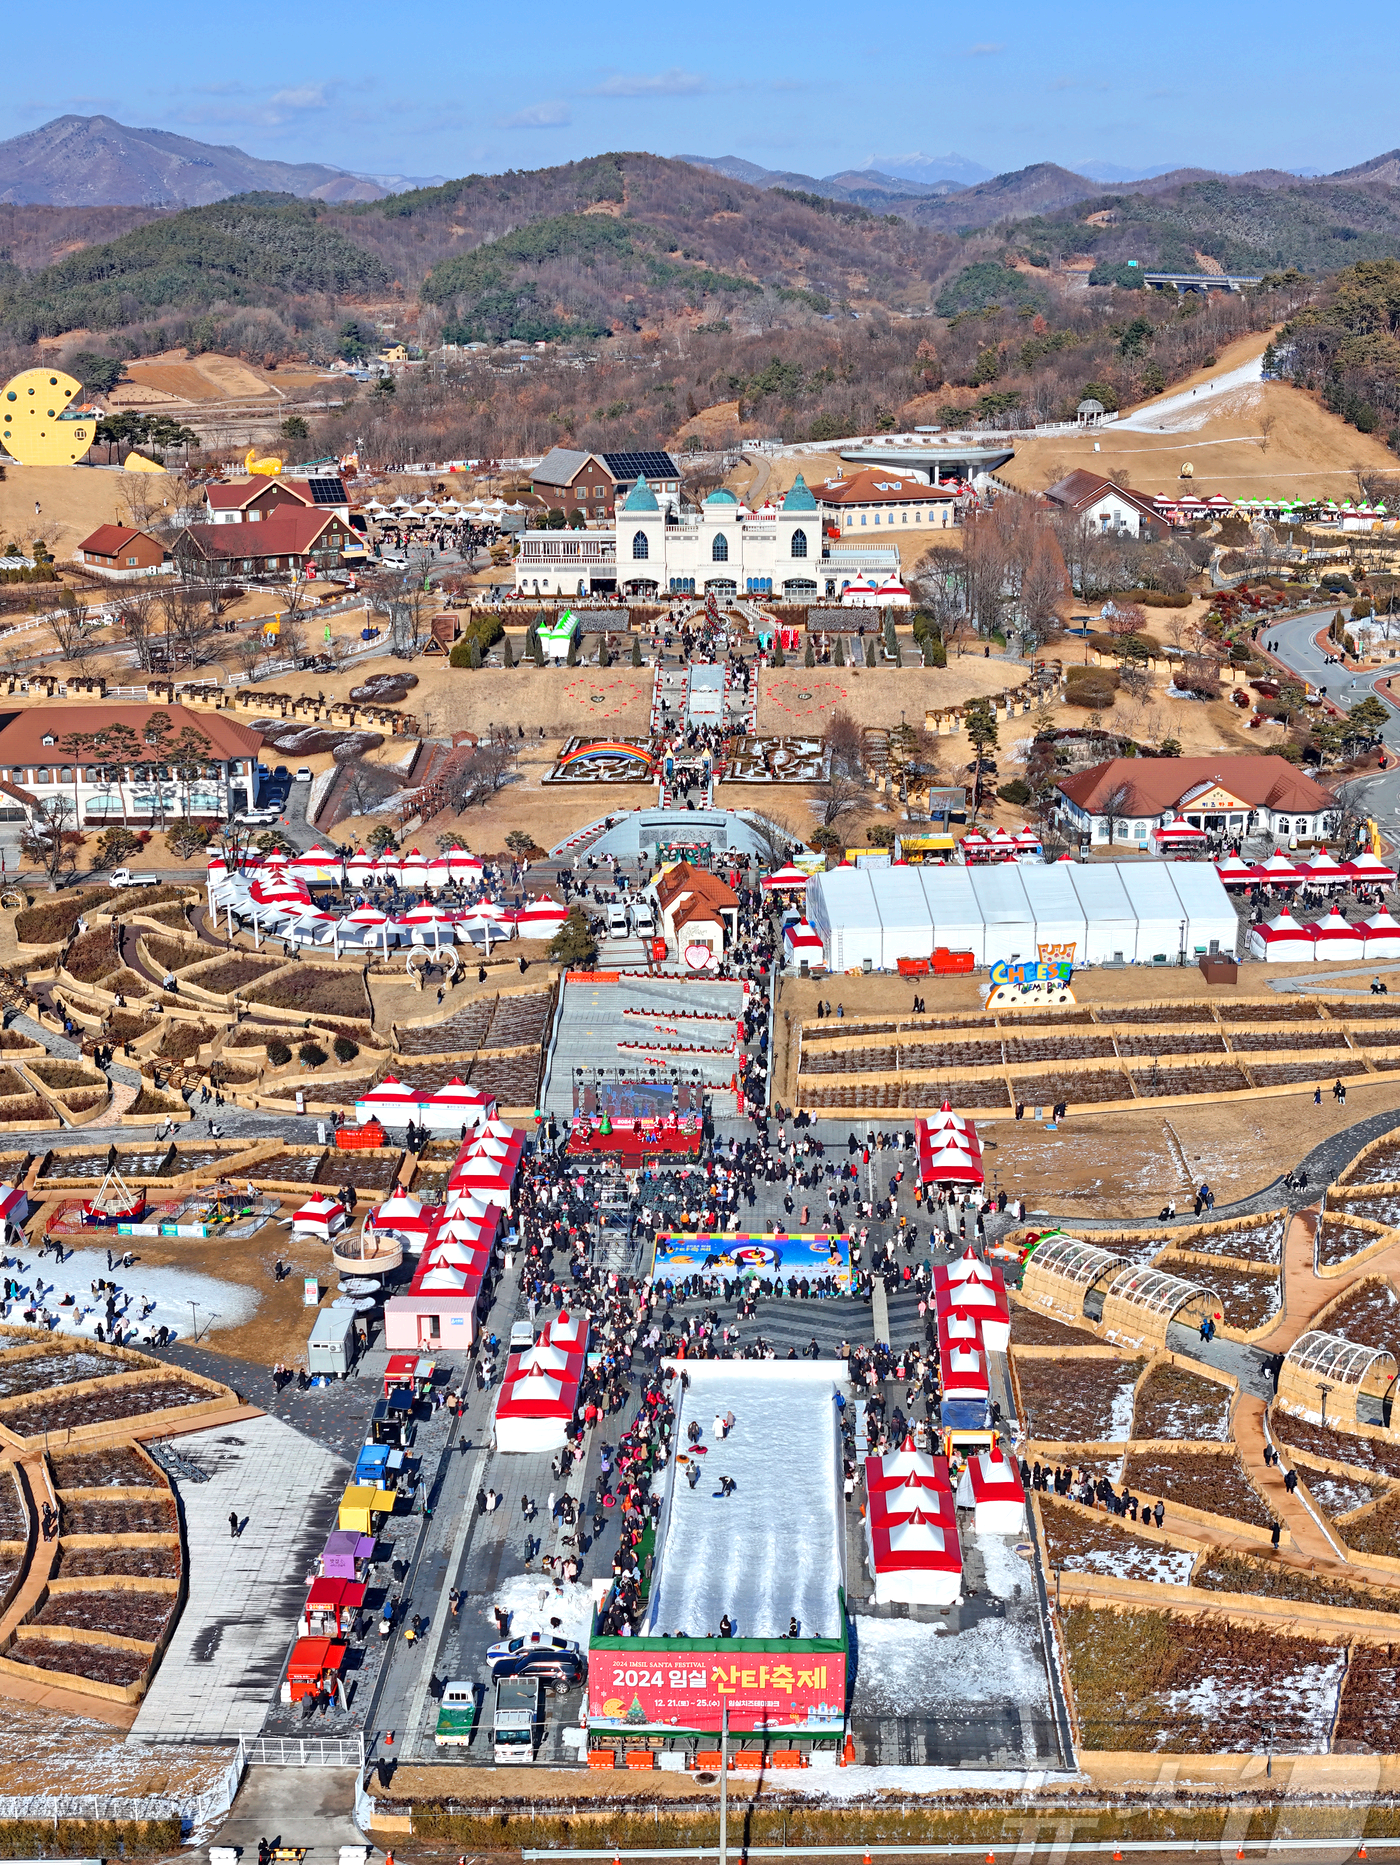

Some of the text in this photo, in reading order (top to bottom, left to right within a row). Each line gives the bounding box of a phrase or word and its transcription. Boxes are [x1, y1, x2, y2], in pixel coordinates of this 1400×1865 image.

[991, 962, 1072, 984] CHEESE
[1015, 981, 1069, 991] THEME PARK
[612, 1664, 827, 1694] 2024 임실 산타축제
[654, 1699, 666, 1707] 12.
[696, 1699, 721, 1707] 25.(수)
